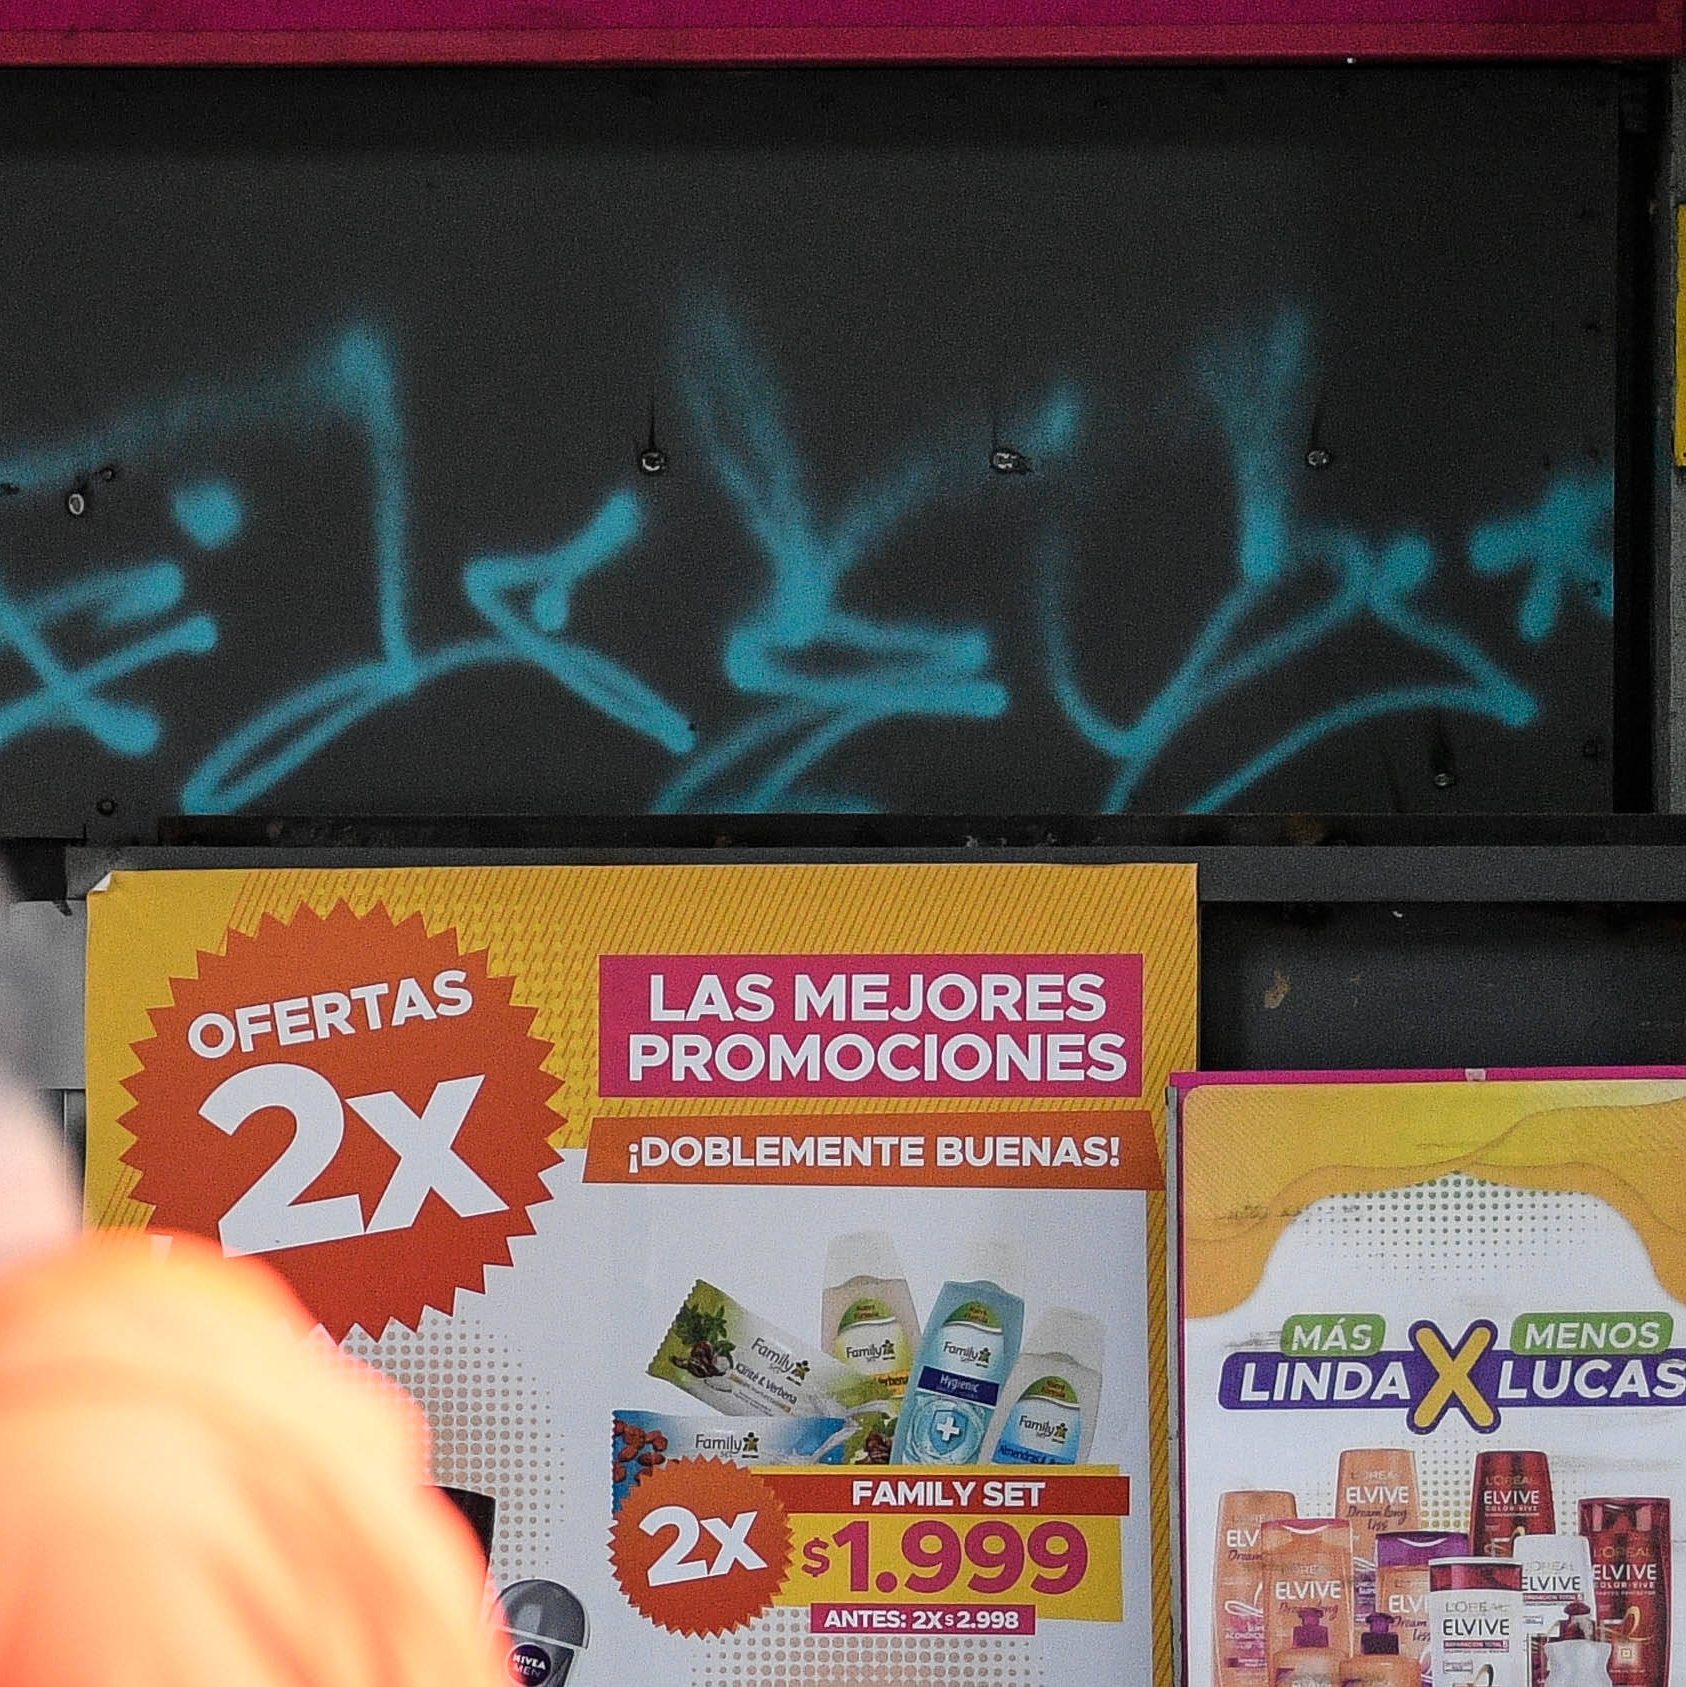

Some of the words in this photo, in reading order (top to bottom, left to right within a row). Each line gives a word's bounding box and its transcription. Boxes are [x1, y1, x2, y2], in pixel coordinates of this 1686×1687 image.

[188, 969, 473, 1059] OFERTAS
[649, 973, 774, 1023] LAS
[795, 973, 1107, 1022] MEJORES
[629, 1033, 1128, 1083] PROMOCIONES
[628, 1136, 926, 1175] ¡DOBLEMENTE
[937, 1136, 1120, 1169] BUENAS!
[1291, 1317, 1373, 1351] MÁS
[1524, 1320, 1661, 1350] MENOS
[1240, 1361, 1411, 1402] LINDA
[1412, 1324, 1496, 1430] X
[1497, 1356, 1686, 1400] LUCAS
[852, 1480, 975, 1508] FAMILY
[983, 1480, 1045, 1508] SET
[802, 1520, 1089, 1597] $1.999
[825, 1610, 907, 1630] ANTES:
[912, 1610, 942, 1630] 2X
[945, 1611, 1019, 1630] $2.998
